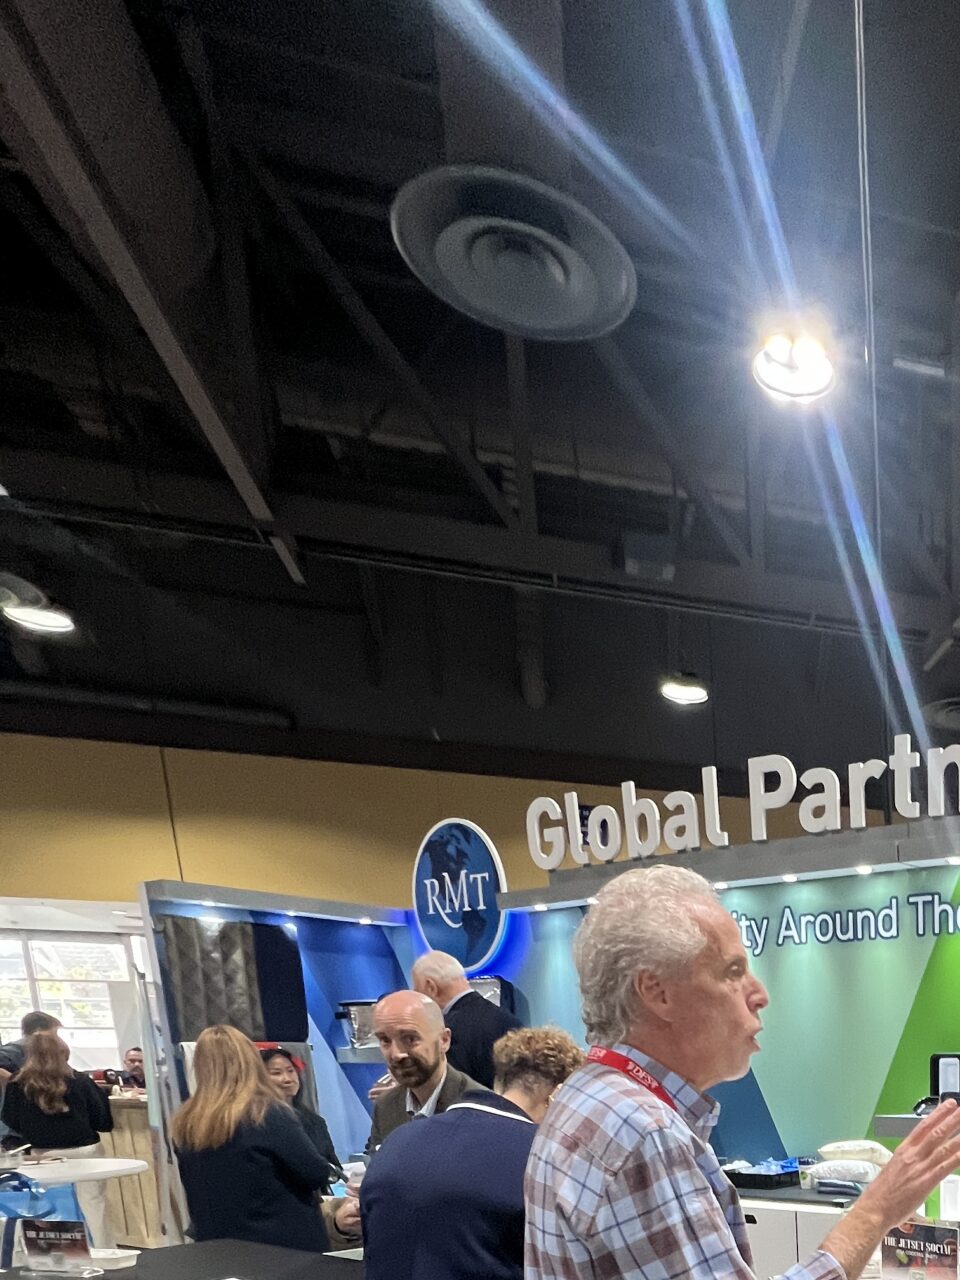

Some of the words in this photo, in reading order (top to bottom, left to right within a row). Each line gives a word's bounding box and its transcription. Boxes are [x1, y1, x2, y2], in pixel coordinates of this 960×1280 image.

[525, 765, 729, 871] Global
[423, 869, 490, 929] RMT
[777, 898, 899, 946] Around
